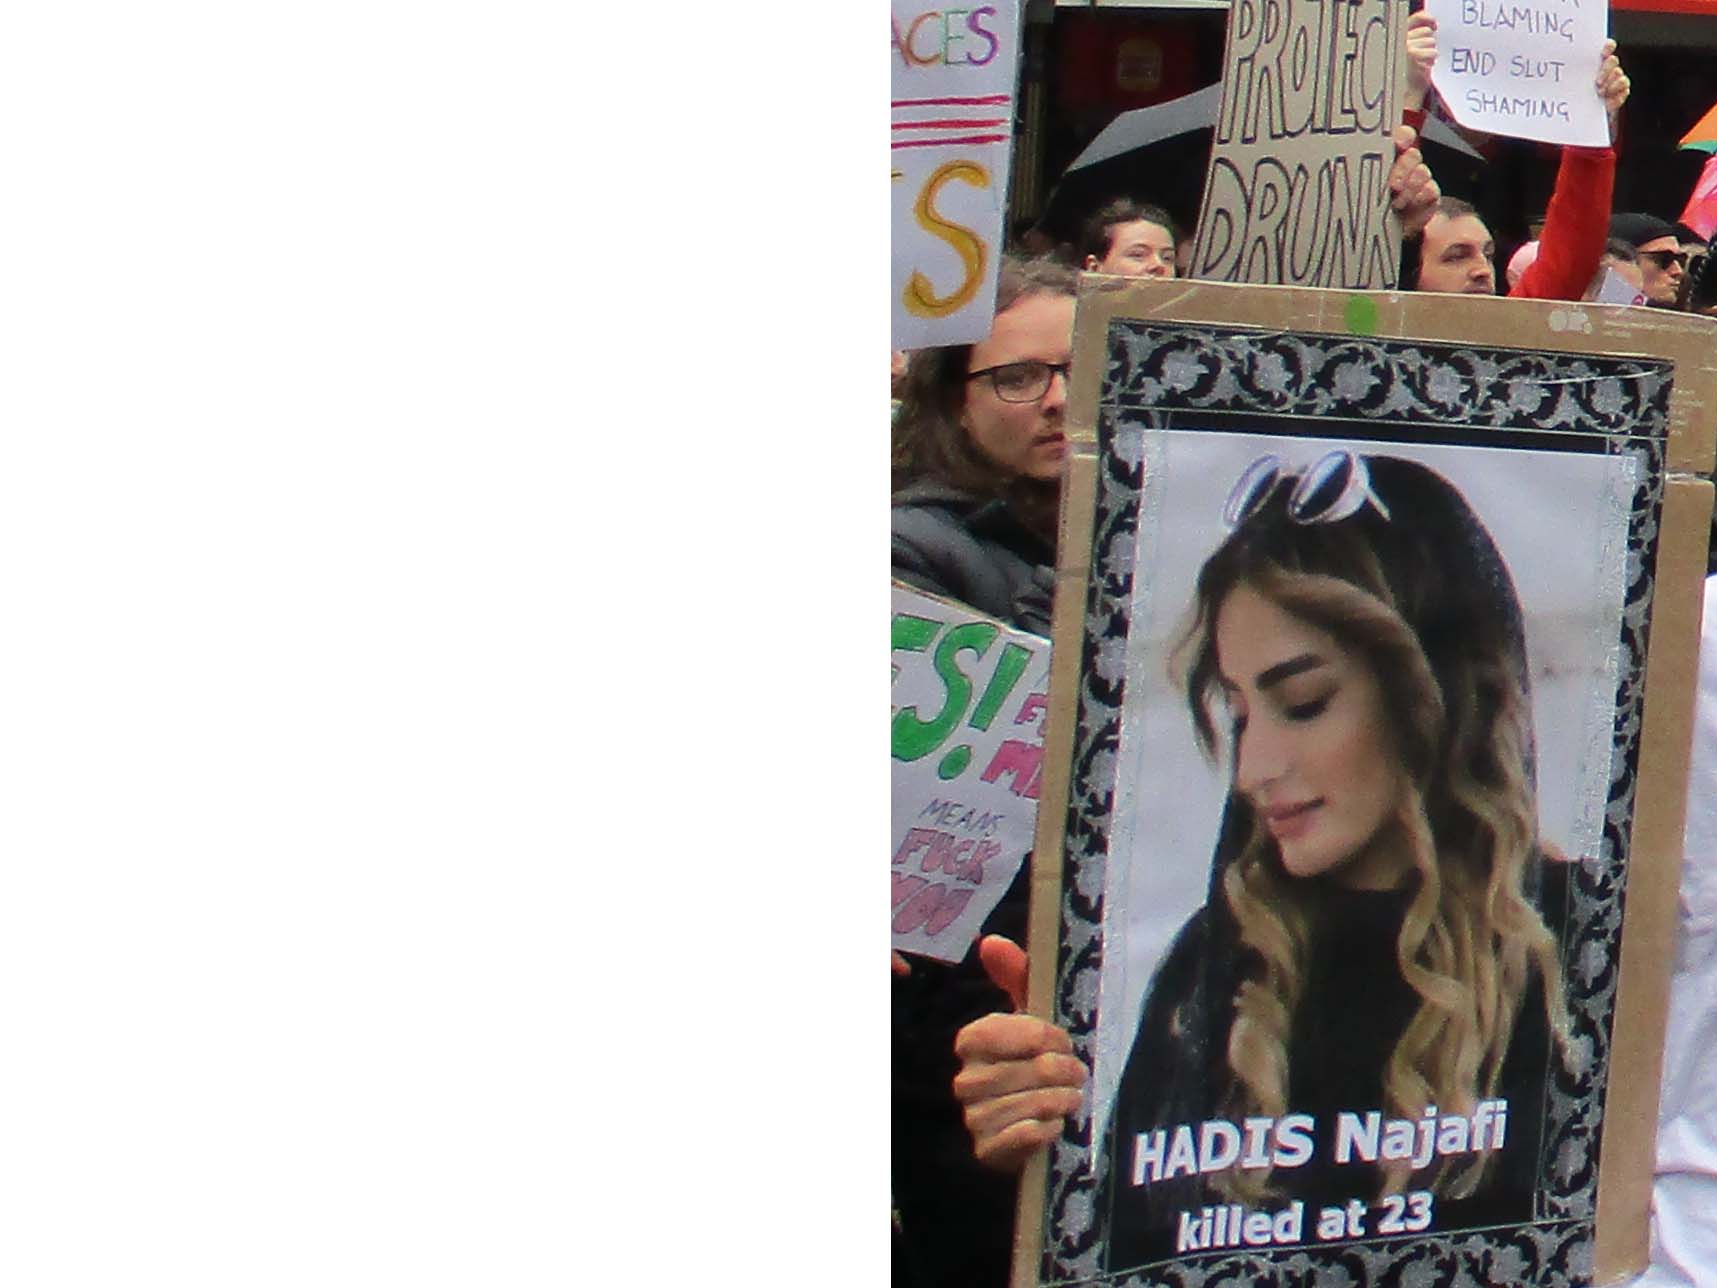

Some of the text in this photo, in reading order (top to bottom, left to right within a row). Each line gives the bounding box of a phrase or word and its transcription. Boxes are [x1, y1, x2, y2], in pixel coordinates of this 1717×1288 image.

[1450, 48, 1566, 84] END SLUT
[1466, 88, 1570, 123] SHAMING
[1190, 150, 1402, 290] DRUNK
[1130, 1099, 1511, 1190] HADIS Najafi
[1176, 1192, 1435, 1254] killed at 23
